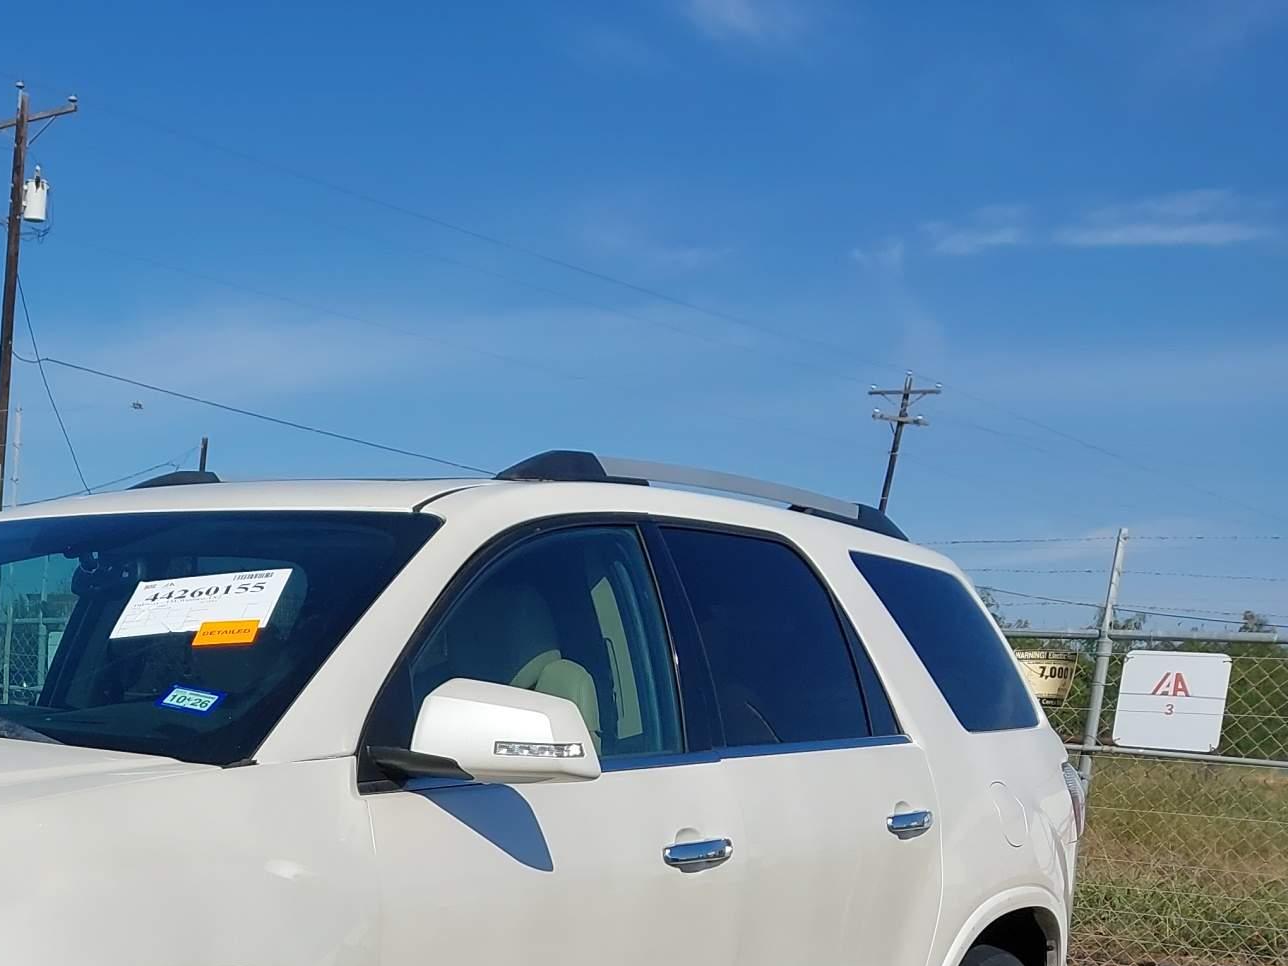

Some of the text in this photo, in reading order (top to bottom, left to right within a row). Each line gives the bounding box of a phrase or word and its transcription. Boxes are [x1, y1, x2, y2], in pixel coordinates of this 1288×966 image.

[145, 582, 266, 602] 44260155
[201, 628, 252, 636] DETAILED
[1038, 665, 1069, 681] 7,000
[190, 698, 211, 709] 26
[1163, 703, 1175, 716] 3
